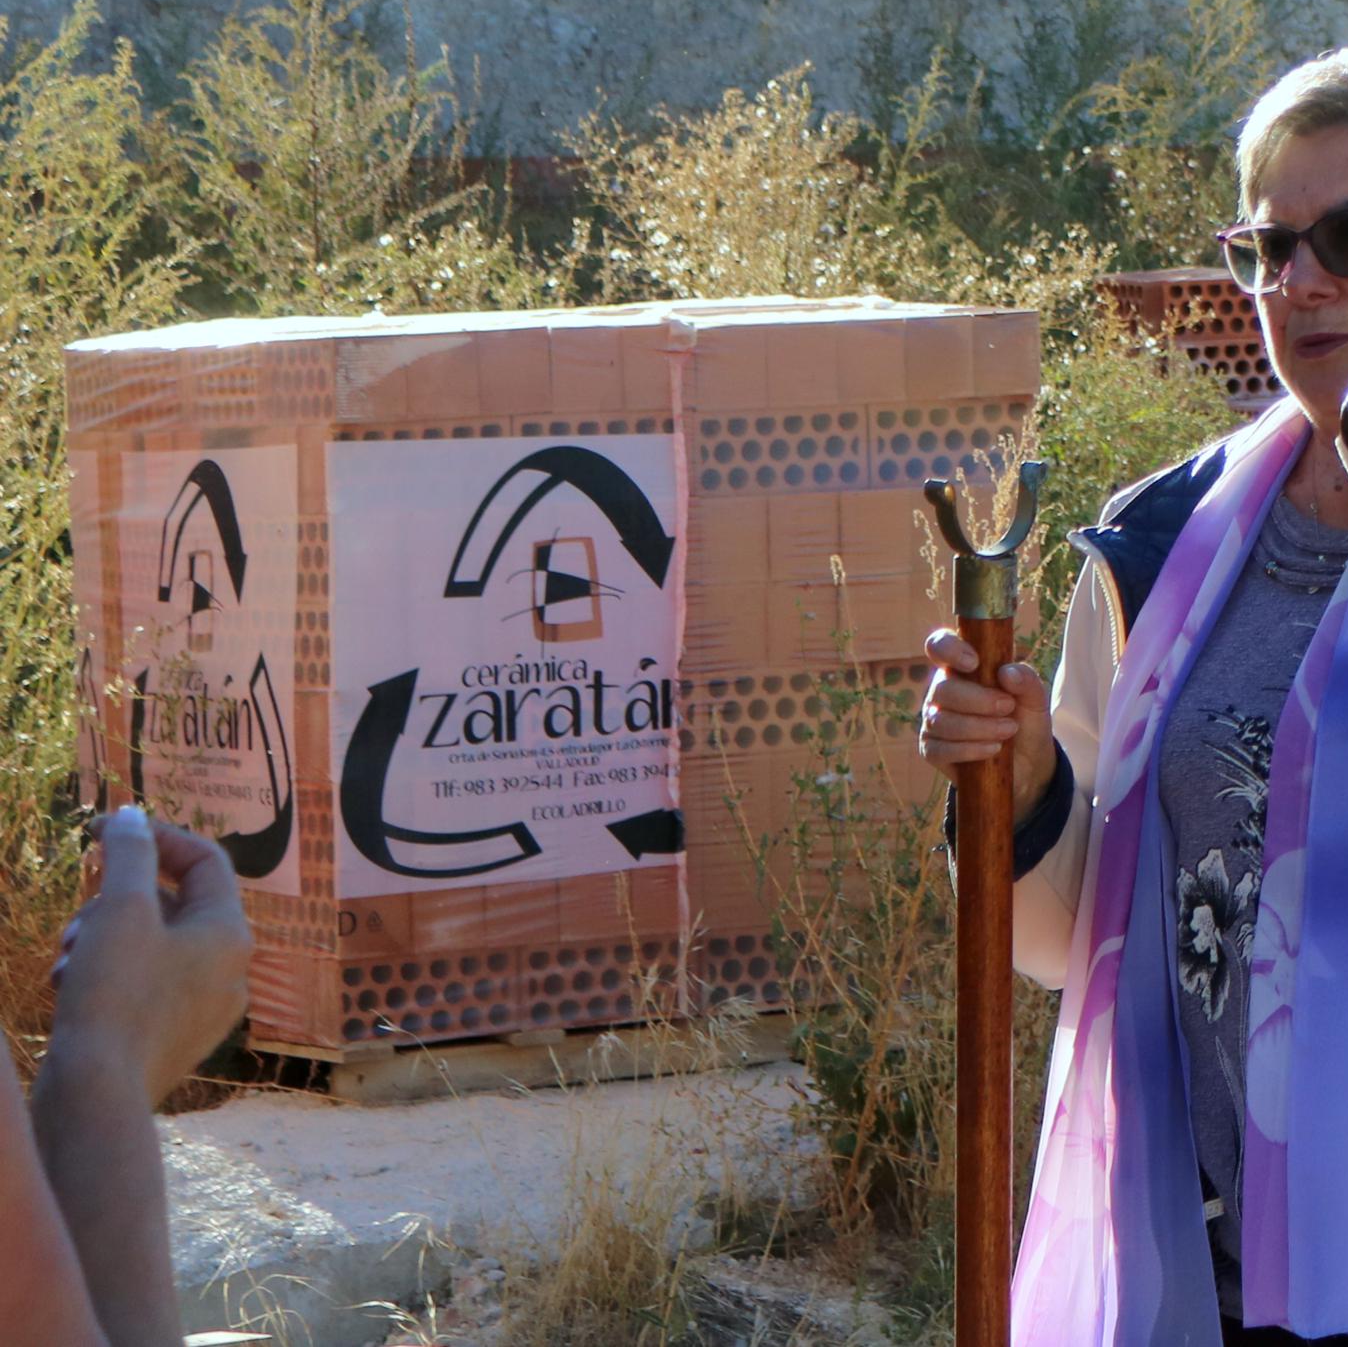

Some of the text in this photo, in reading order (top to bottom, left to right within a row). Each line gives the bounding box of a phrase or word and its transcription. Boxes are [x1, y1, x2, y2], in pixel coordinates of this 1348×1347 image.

[461, 653, 588, 688] cerámica
[463, 779, 495, 795] 983
[501, 773, 563, 793] 392544
[607, 766, 638, 783] 983
[531, 799, 625, 821] ECOLADRILLO
